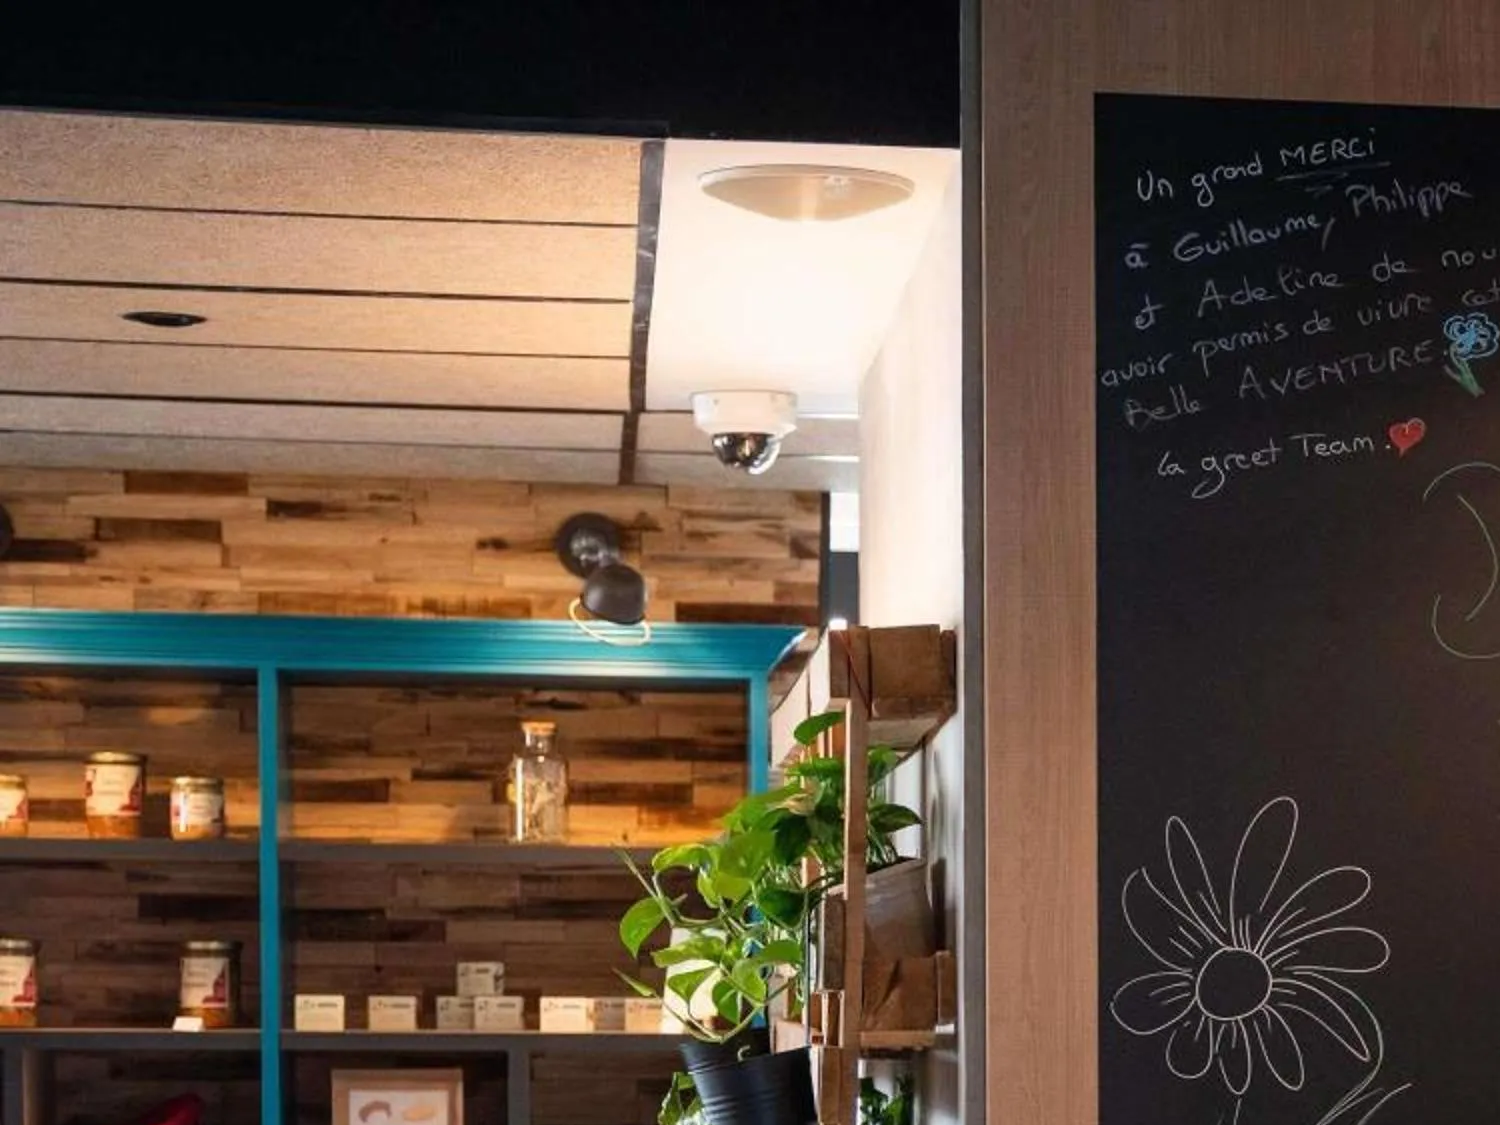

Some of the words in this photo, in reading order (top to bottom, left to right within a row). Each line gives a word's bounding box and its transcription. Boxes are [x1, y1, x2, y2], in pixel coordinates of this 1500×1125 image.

[1137, 170, 1174, 201] Un
[1191, 155, 1264, 207] grand
[1345, 179, 1474, 218] Philippe
[1134, 296, 1164, 330] et
[1197, 271, 1343, 317] Adeline
[1372, 253, 1417, 283] de
[1101, 353, 1174, 387] avoir
[1192, 320, 1289, 377] permis
[1302, 313, 1336, 337] de
[1356, 291, 1433, 327] vivre
[1191, 442, 1283, 500] greet
